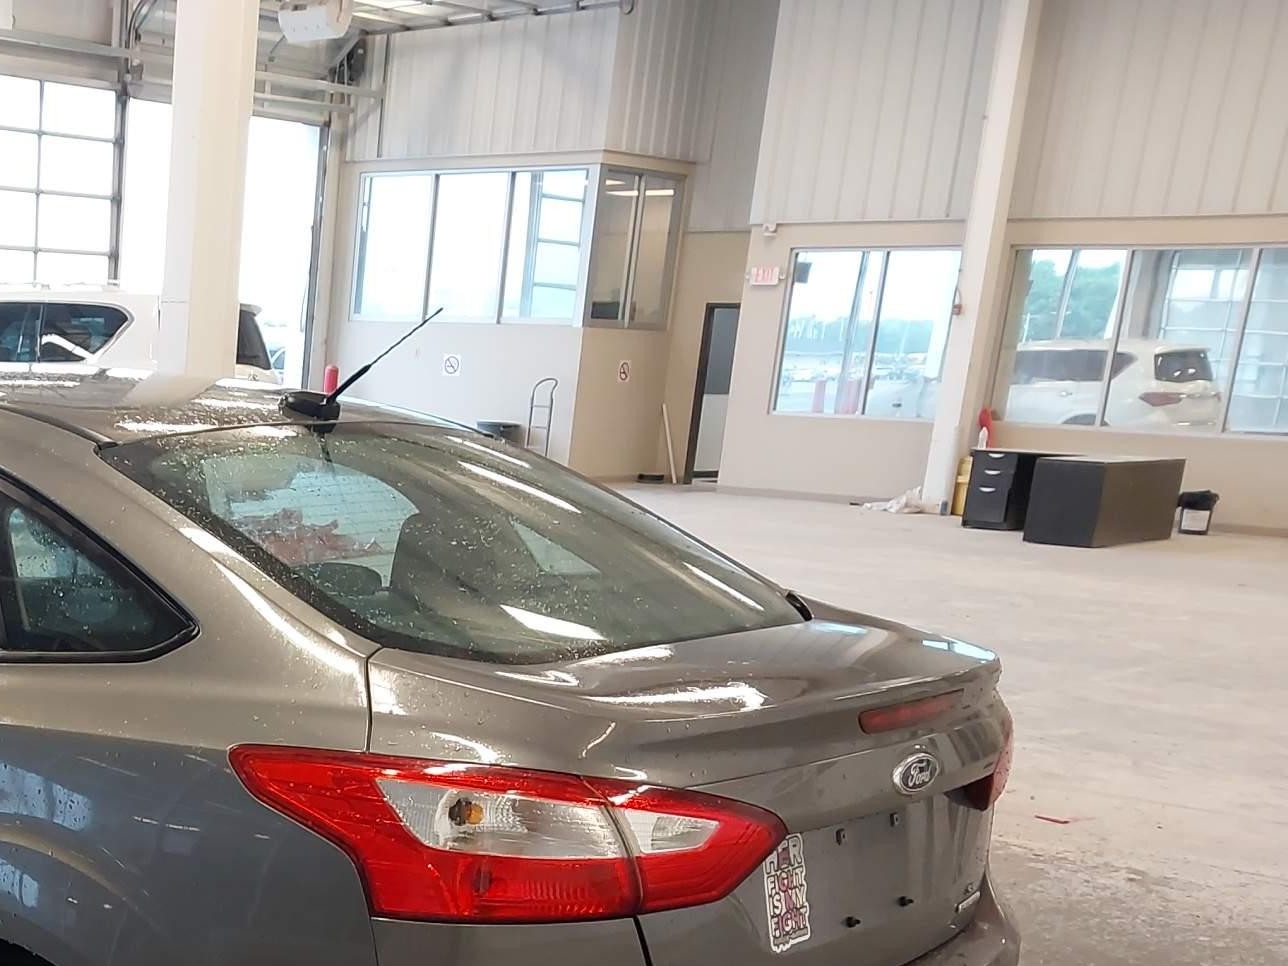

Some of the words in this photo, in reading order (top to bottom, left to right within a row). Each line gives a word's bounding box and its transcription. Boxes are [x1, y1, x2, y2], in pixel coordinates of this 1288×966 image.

[767, 866, 804, 897] FIGHT
[768, 892, 782, 917] IS
[783, 885, 805, 911] MY
[771, 907, 808, 938] FIGHT
